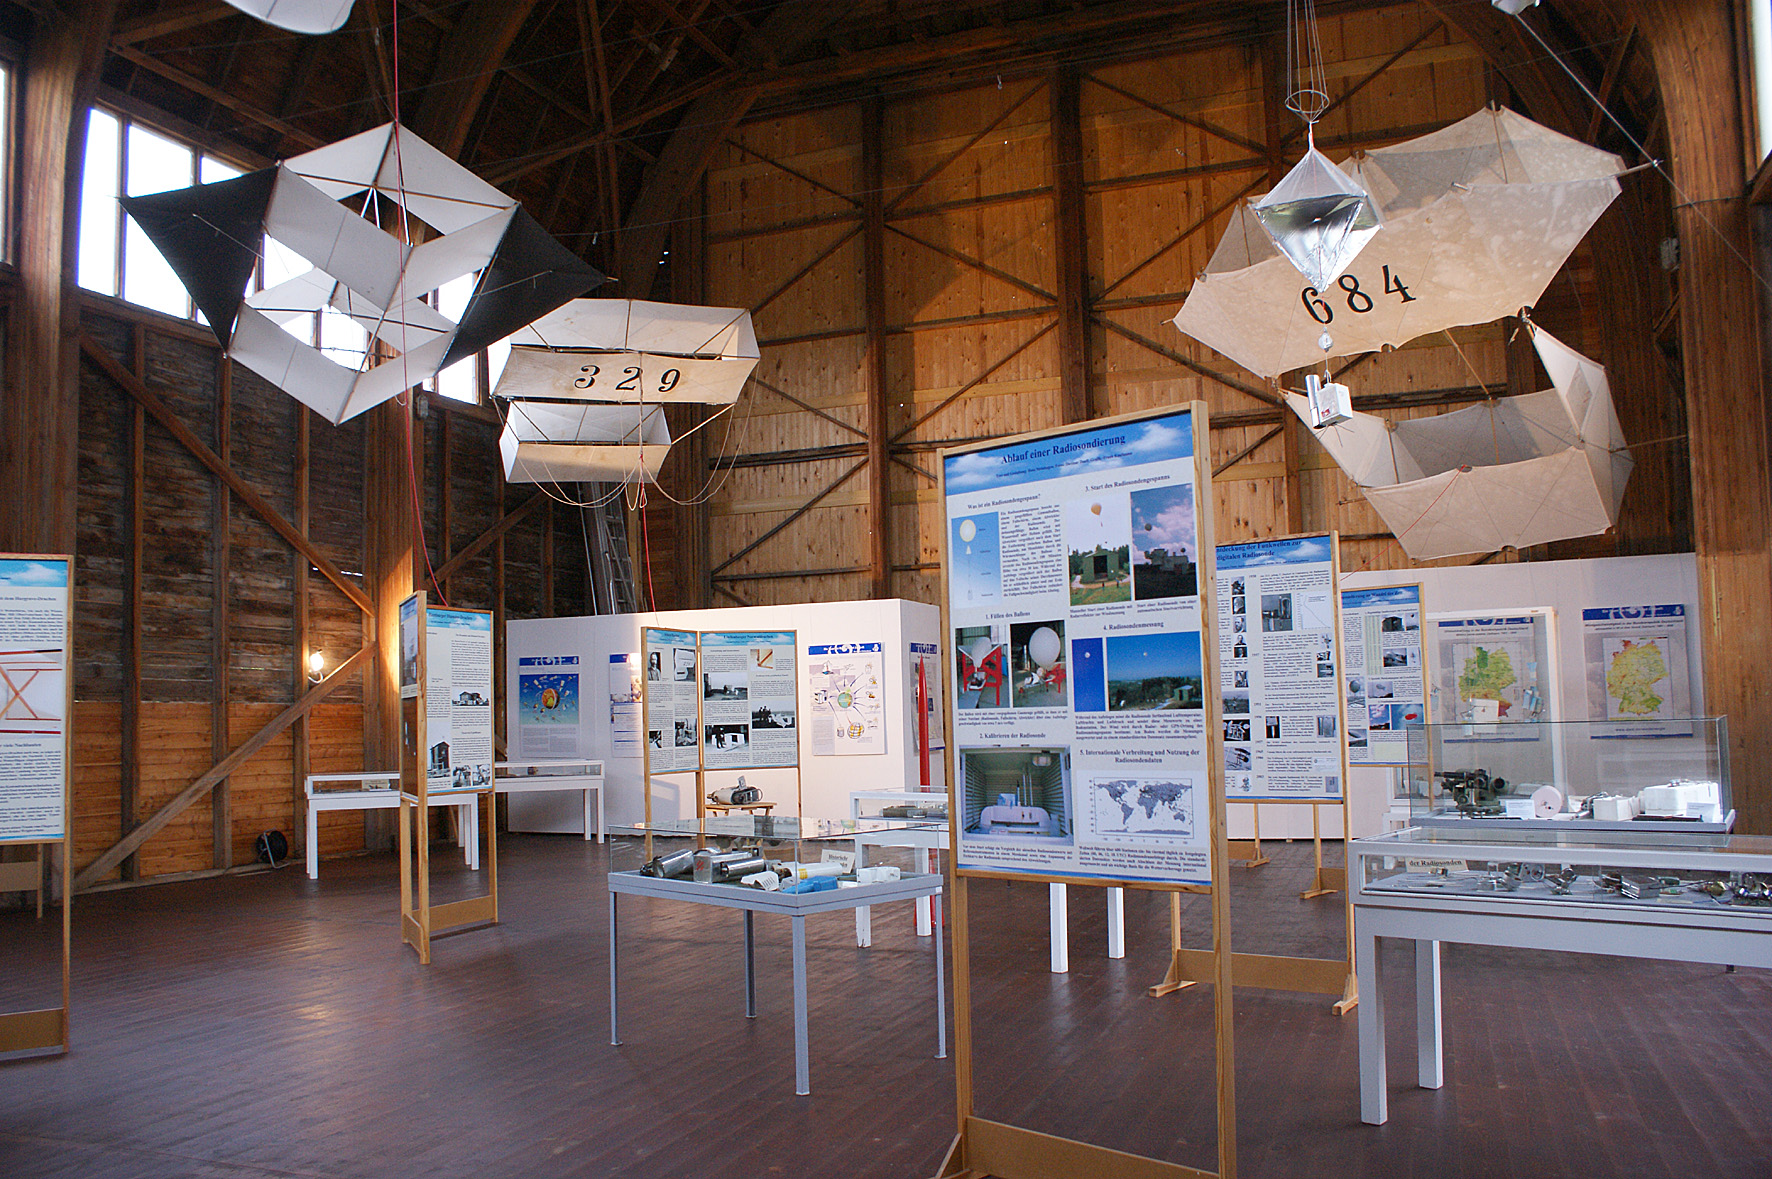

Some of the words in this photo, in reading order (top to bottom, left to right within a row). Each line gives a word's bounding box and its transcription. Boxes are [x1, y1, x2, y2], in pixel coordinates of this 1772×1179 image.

[1300, 264, 1416, 324] 684
[574, 364, 681, 392] 329
[1000, 450, 1028, 464] Ablauf
[1030, 448, 1050, 459] einer
[1052, 435, 1126, 455] Radiosondierung
[1114, 474, 1170, 487] Radiosondengespanns
[1257, 540, 1290, 549] Funkwellen
[1109, 622, 1164, 630] Radiosondenmessung
